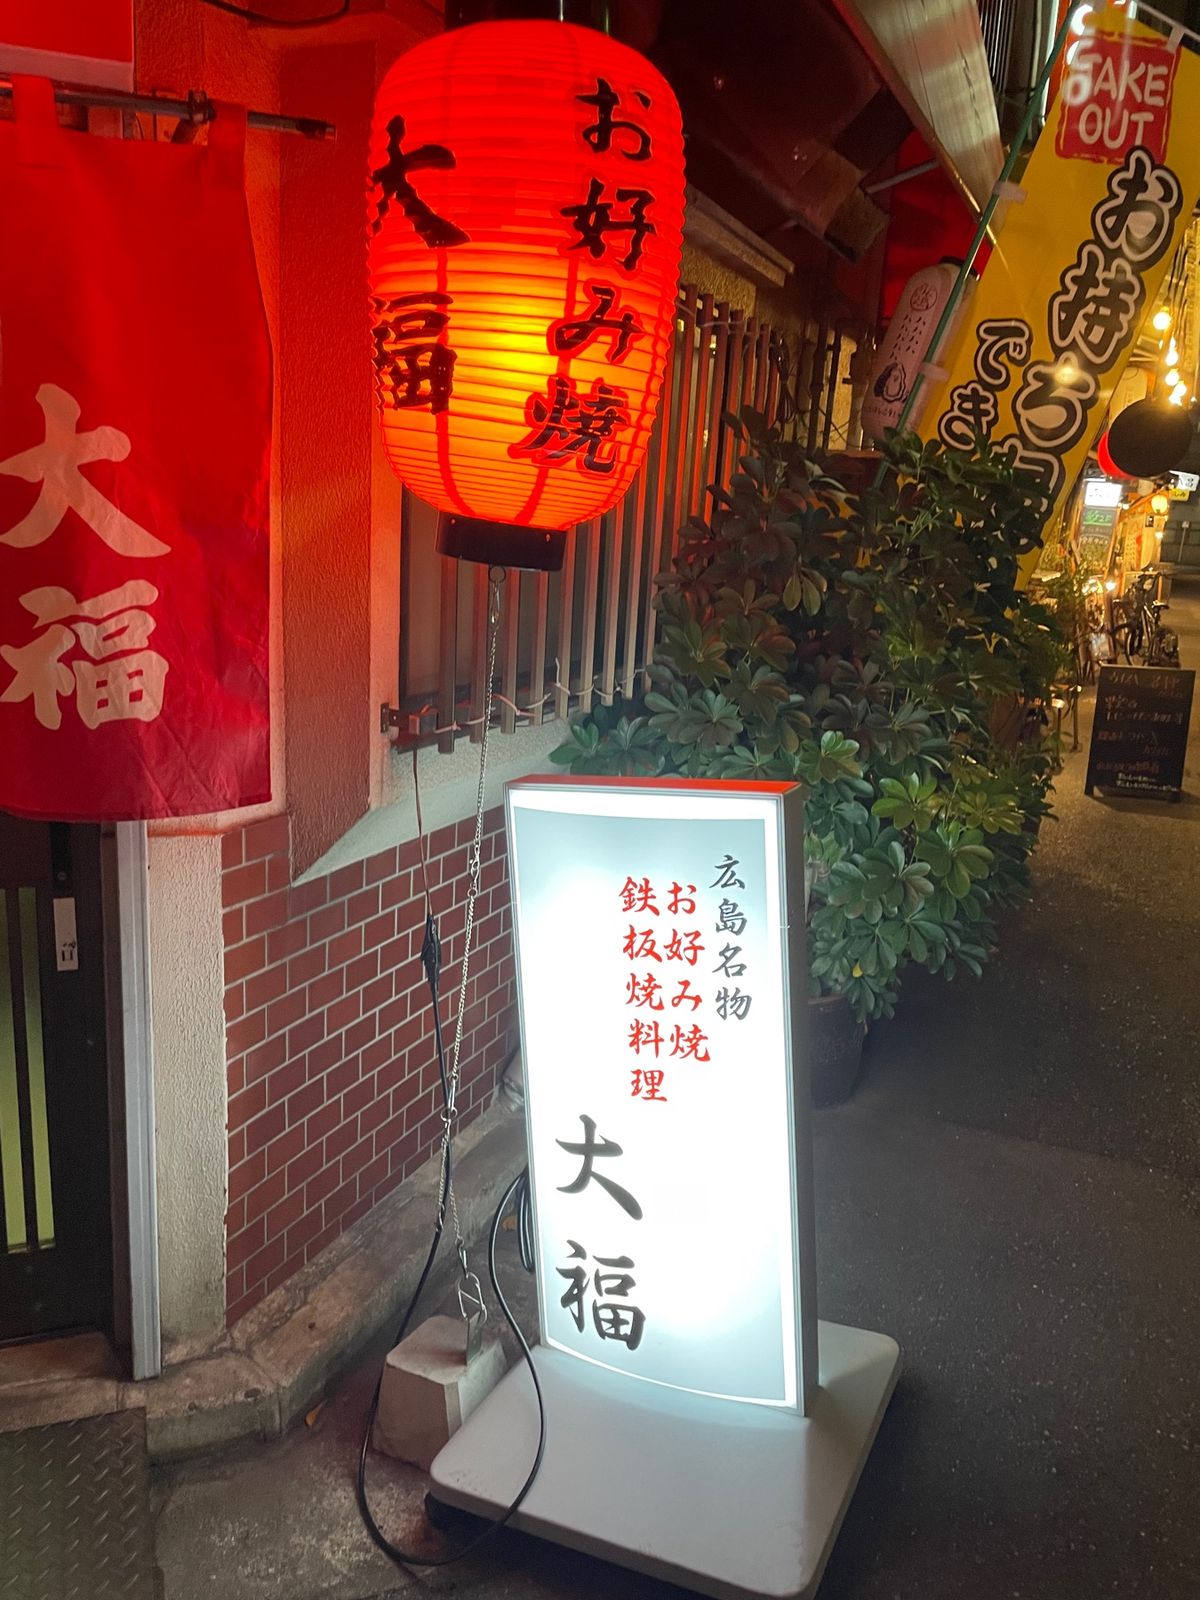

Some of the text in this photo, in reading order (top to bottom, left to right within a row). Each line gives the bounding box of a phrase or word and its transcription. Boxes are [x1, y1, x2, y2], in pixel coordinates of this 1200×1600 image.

[1078, 53, 1168, 107] TAKE
[1078, 103, 1155, 149] OUT
[367, 114, 471, 416] 大福
[511, 76, 657, 474] お好み焼
[0, 383, 172, 731] 大福
[618, 876, 669, 1103] 鉄板焼料理
[662, 880, 712, 1064] お好み焼
[707, 853, 753, 1022] 広島名物
[554, 1113, 647, 1352] 大福
